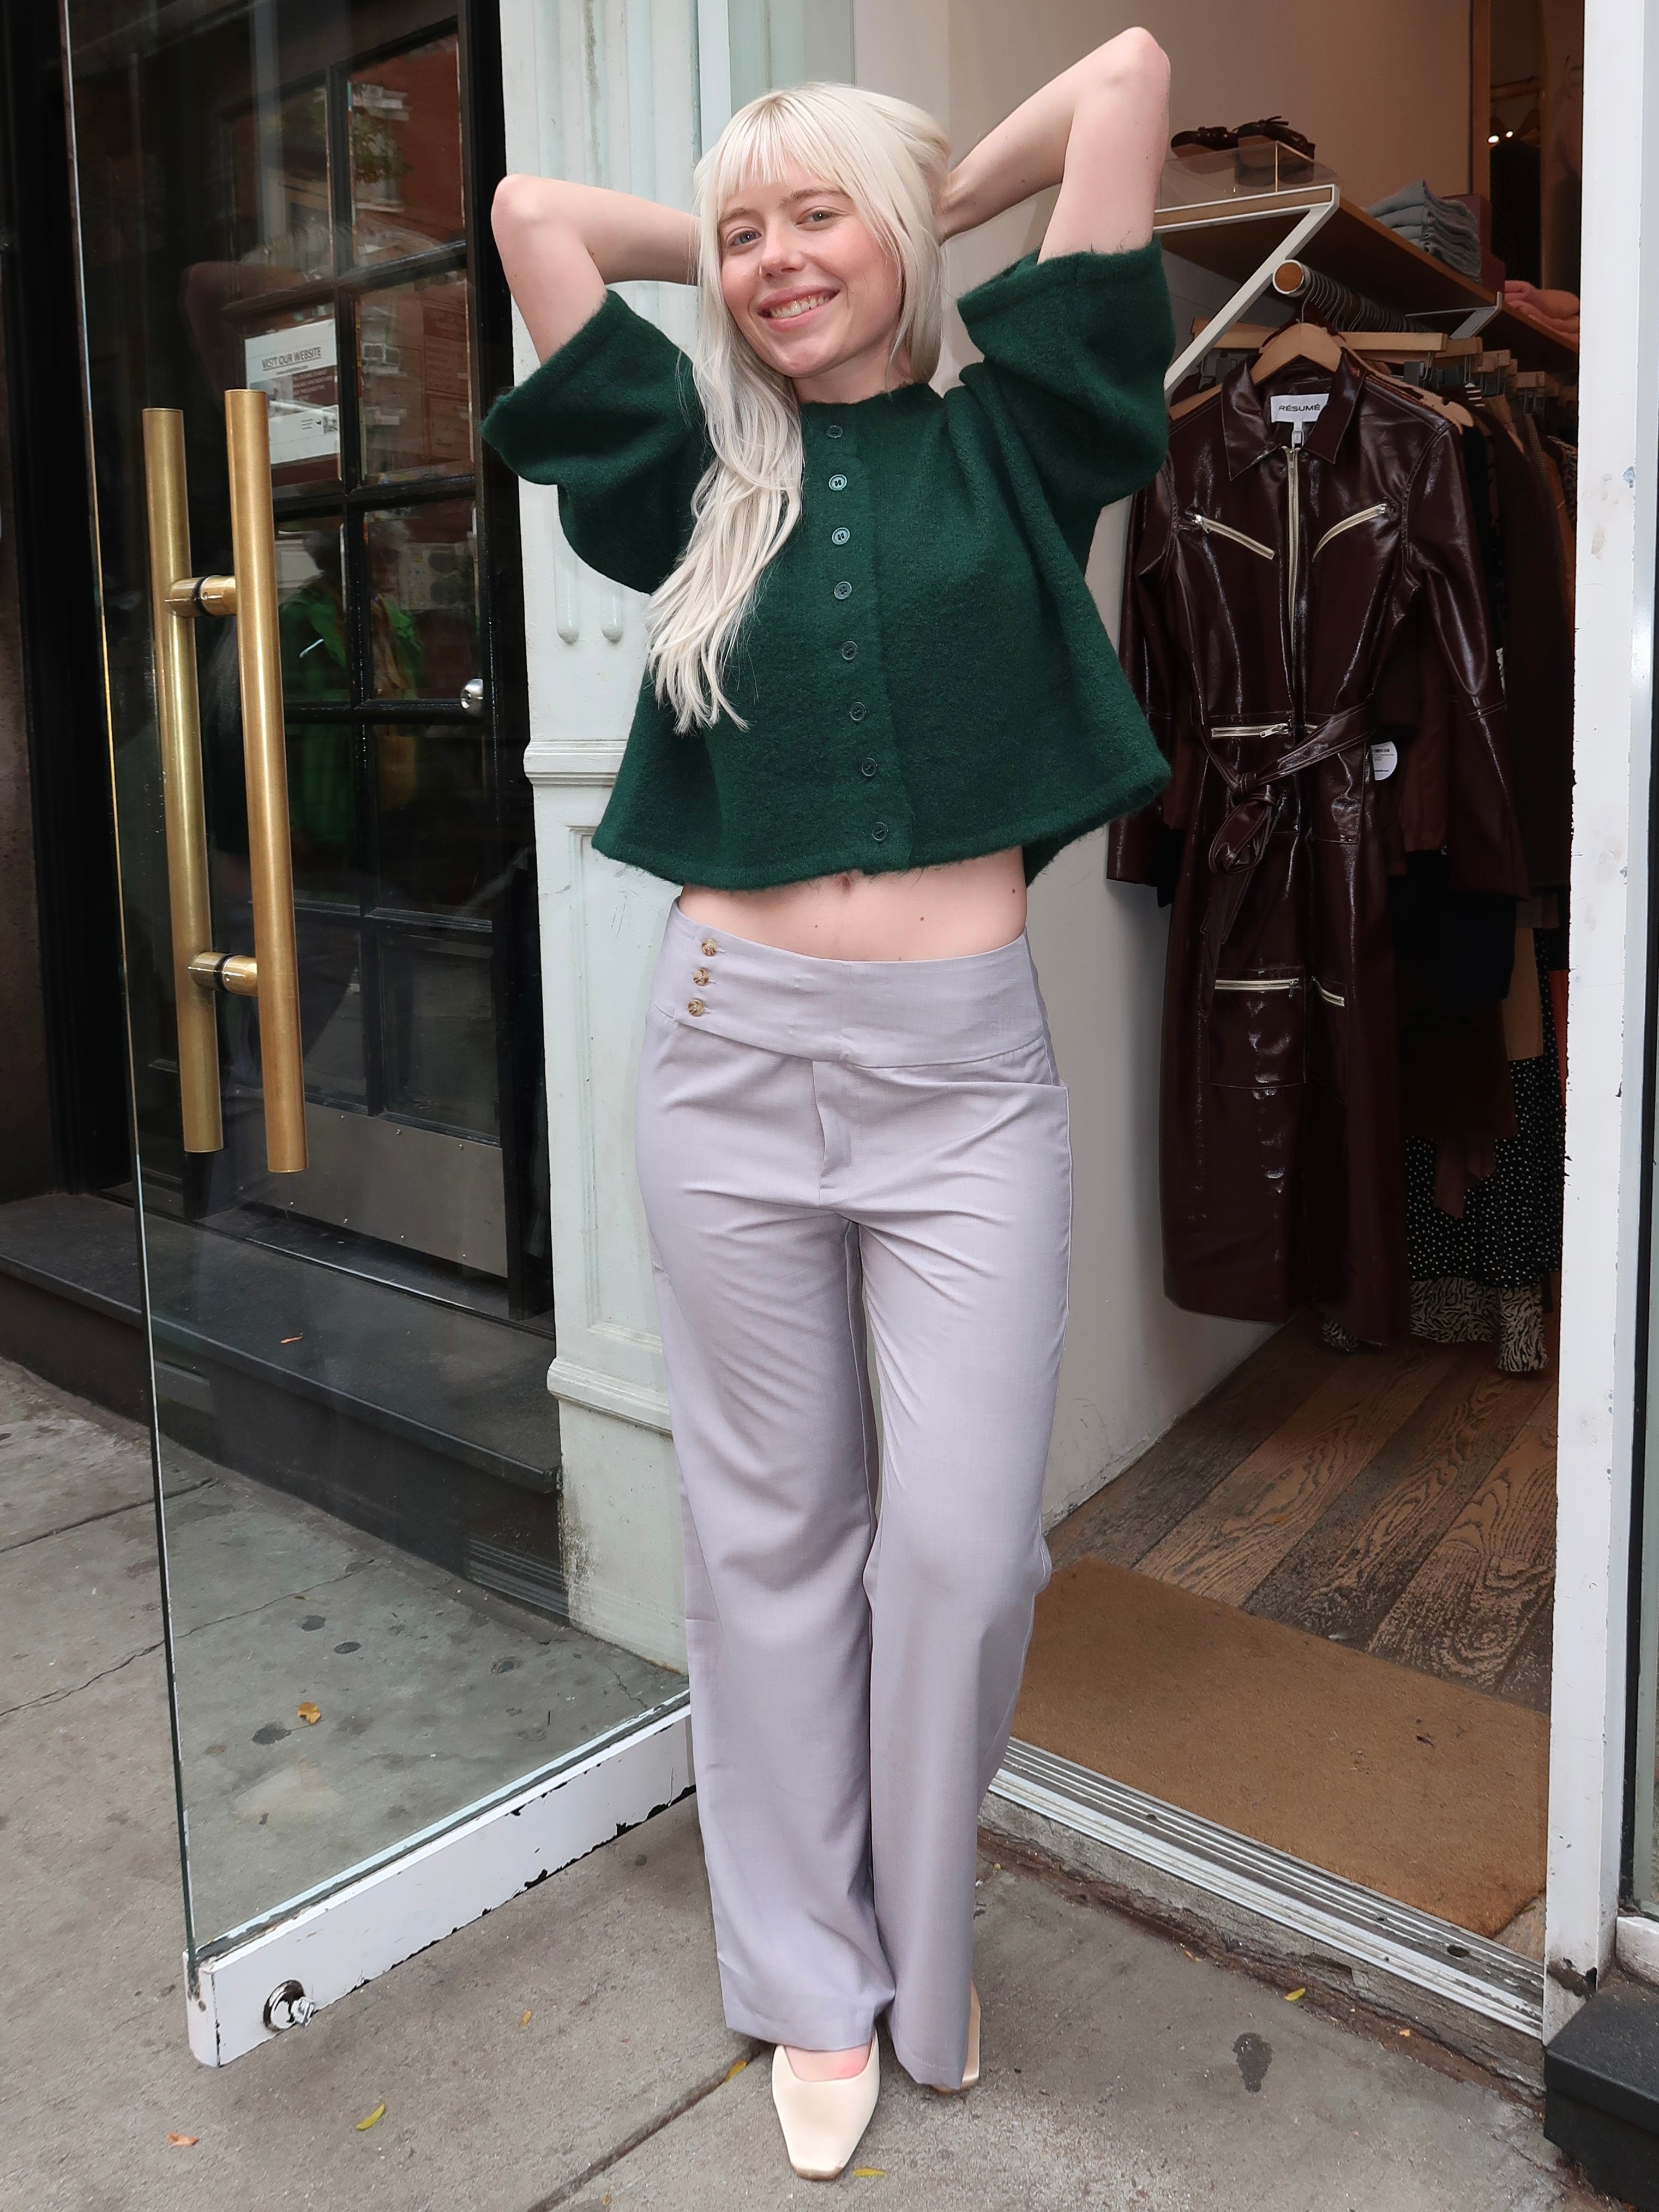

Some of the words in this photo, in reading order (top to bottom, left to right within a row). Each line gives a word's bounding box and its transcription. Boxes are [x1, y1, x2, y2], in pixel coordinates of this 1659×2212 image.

[262, 356, 278, 368] VISIT
[279, 353, 293, 365] OUR
[293, 346, 321, 361] WEBSITE
[1278, 404, 1320, 412] RÉSUMÉ
